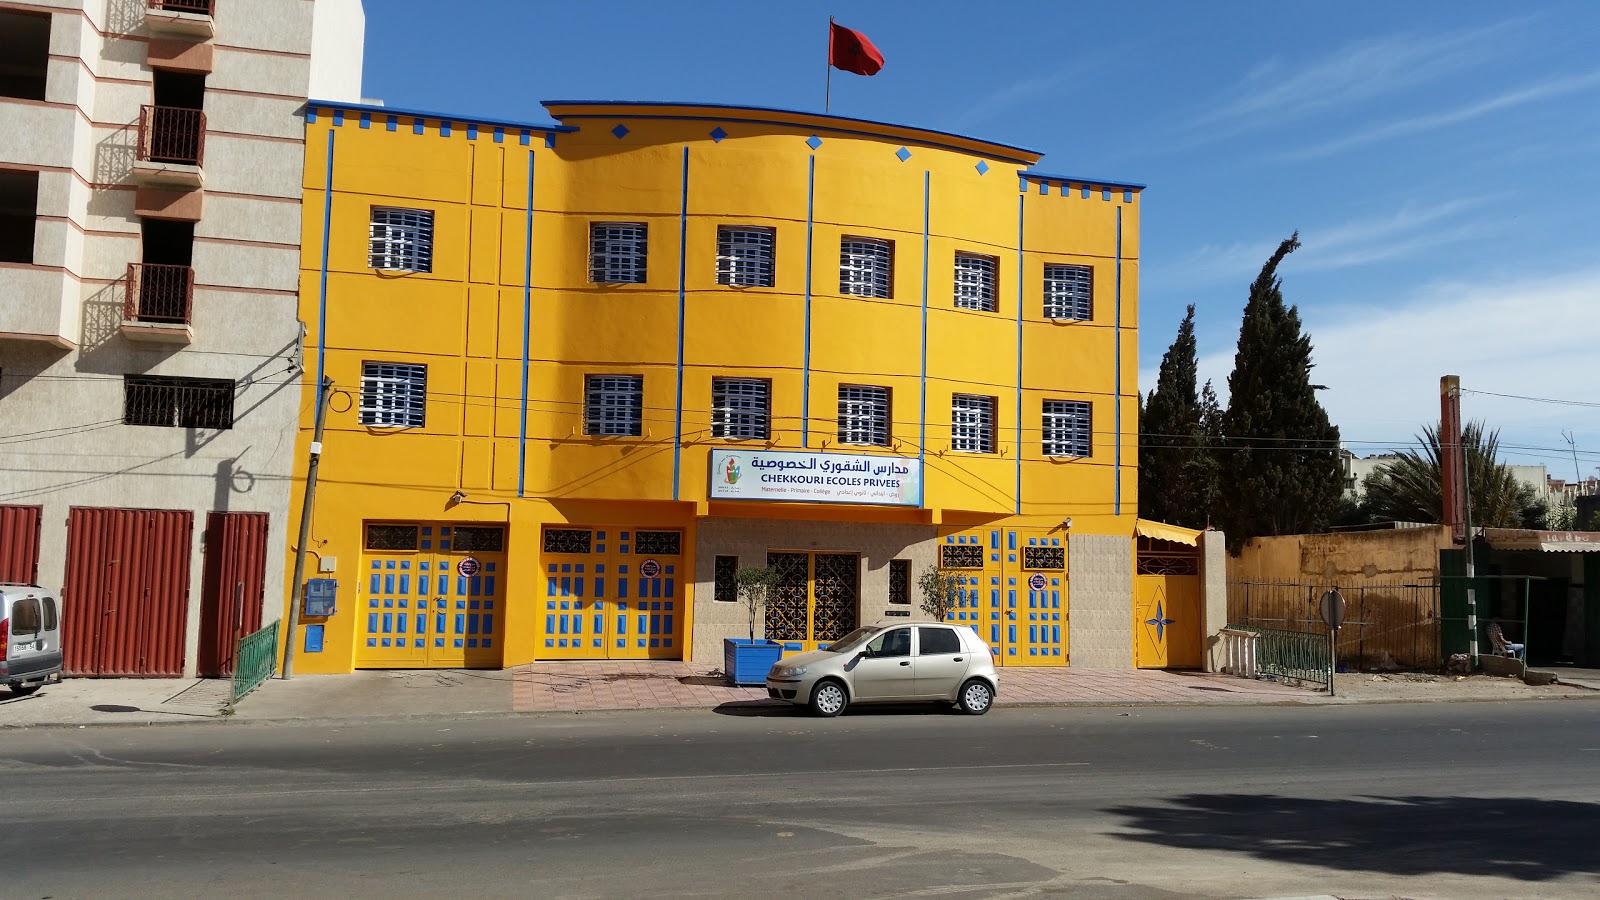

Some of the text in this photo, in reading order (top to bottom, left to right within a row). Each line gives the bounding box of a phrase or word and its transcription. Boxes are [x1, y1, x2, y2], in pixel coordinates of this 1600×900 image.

[751, 457, 817, 471] الخصوصية
[820, 459, 870, 473] الشقوري
[873, 462, 909, 476] مدارس
[761, 474, 900, 488] CHEKKOURI ECOLES PRIVEES
